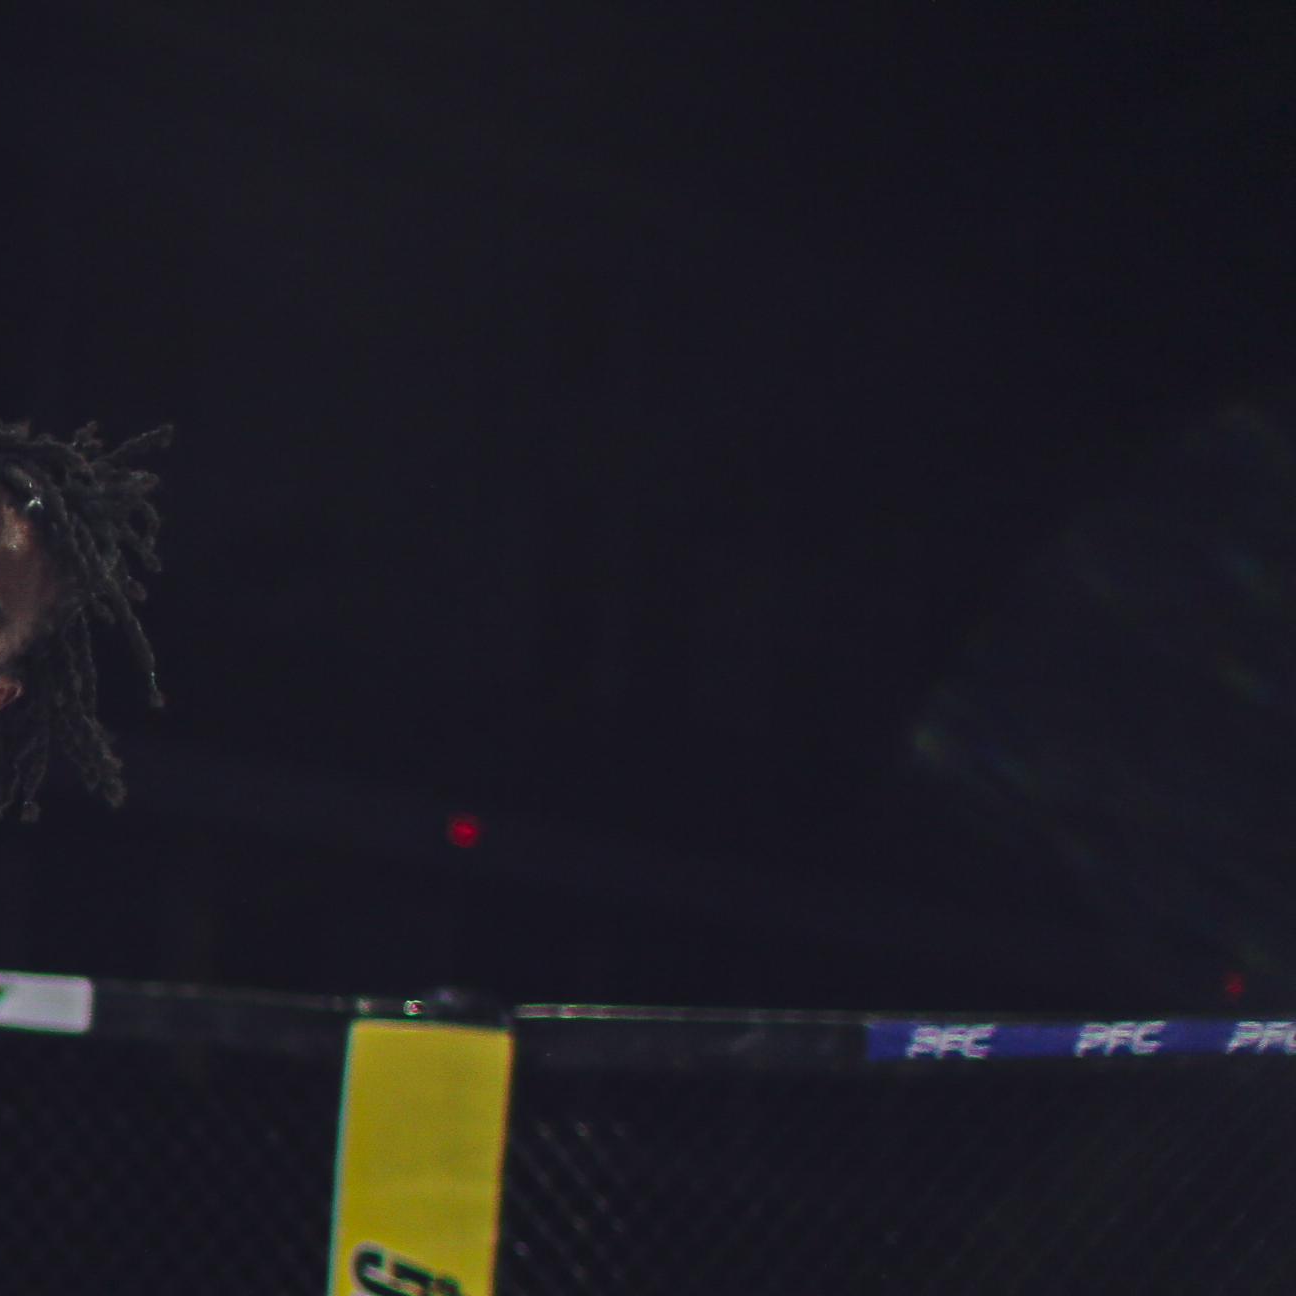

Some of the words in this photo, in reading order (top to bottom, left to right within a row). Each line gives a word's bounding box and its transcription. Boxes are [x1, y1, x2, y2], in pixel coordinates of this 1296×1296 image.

[906, 1023, 996, 1060] PFC
[1073, 1020, 1168, 1058] PFC
[1223, 1020, 1296, 1055] PF
